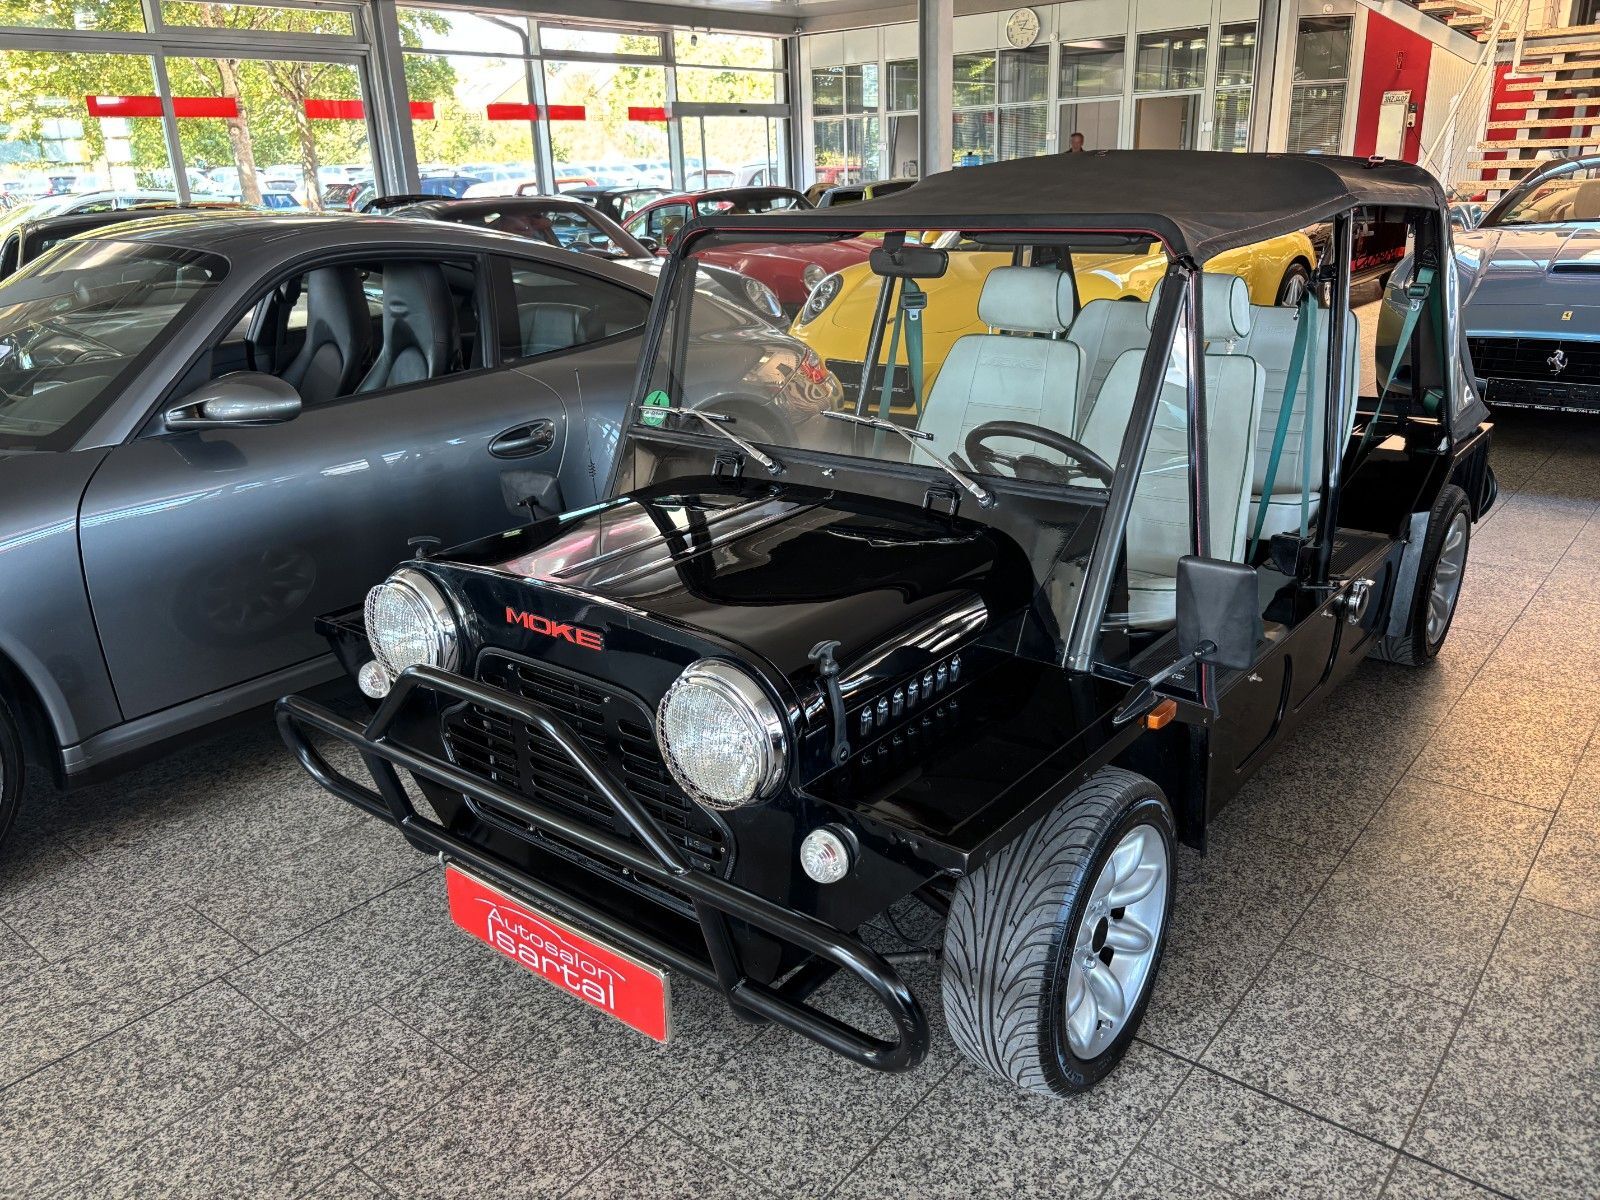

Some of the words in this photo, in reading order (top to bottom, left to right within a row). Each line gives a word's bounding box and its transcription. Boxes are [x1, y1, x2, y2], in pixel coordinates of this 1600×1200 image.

[505, 605, 602, 651] MOKE
[487, 907, 613, 985] Autosalon
[487, 917, 615, 1010] Isartal
